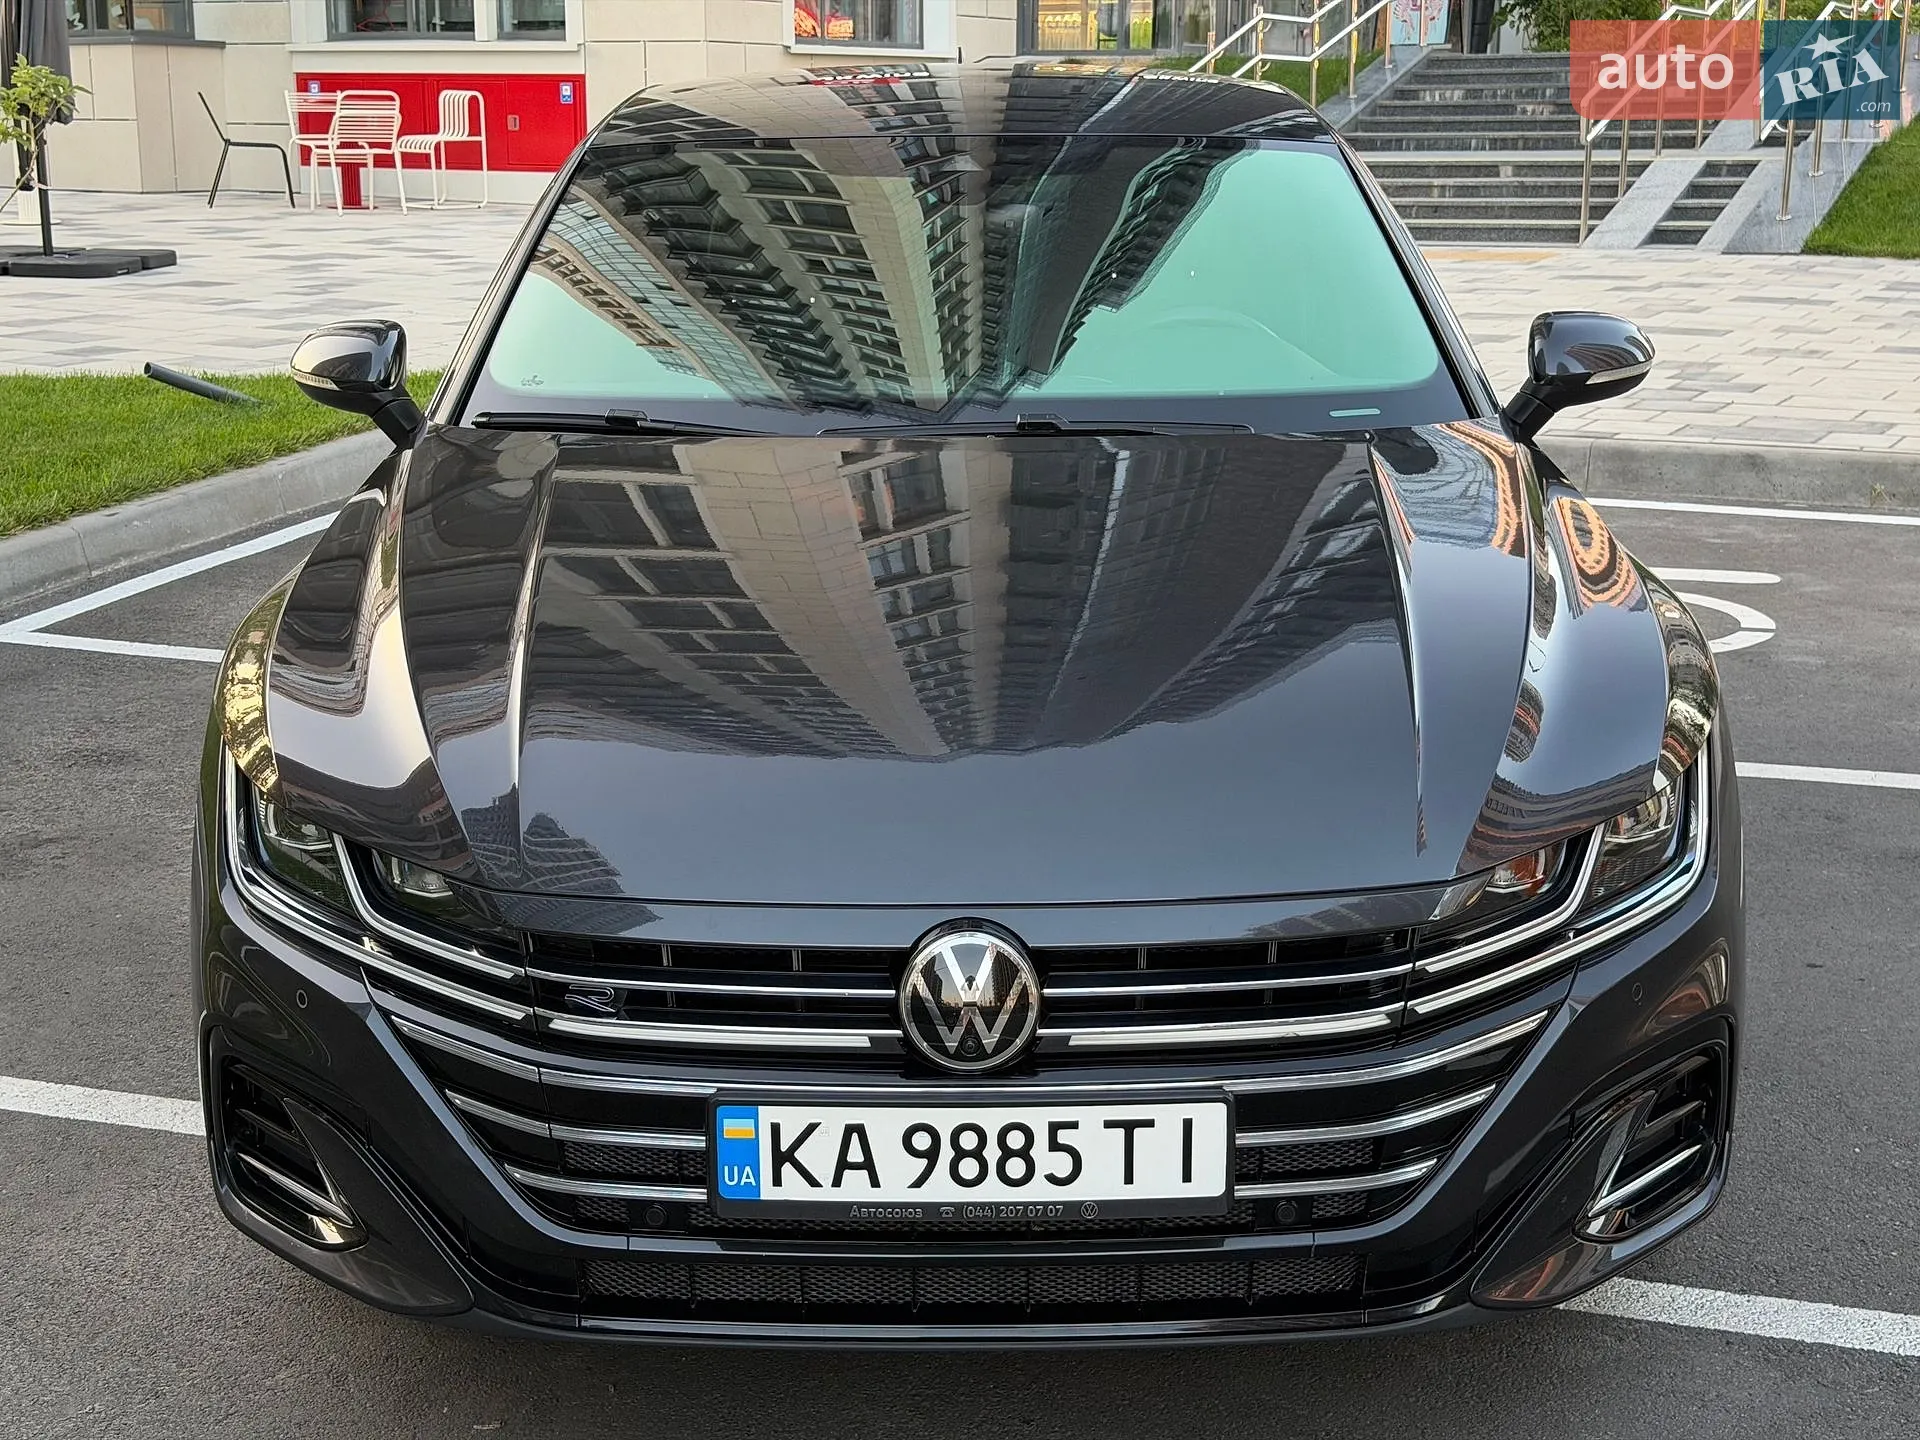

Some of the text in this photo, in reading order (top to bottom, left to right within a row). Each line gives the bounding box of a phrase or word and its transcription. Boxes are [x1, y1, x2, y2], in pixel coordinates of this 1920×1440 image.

[908, 938, 1034, 1060] VW
[723, 1165, 757, 1187] UA
[770, 1118, 1193, 1188] KA 9885 TI
[962, 1205, 996, 1218] (044)
[1000, 1205, 1024, 1217] 207
[1027, 1205, 1044, 1217] 07
[1047, 1205, 1064, 1217] 07
